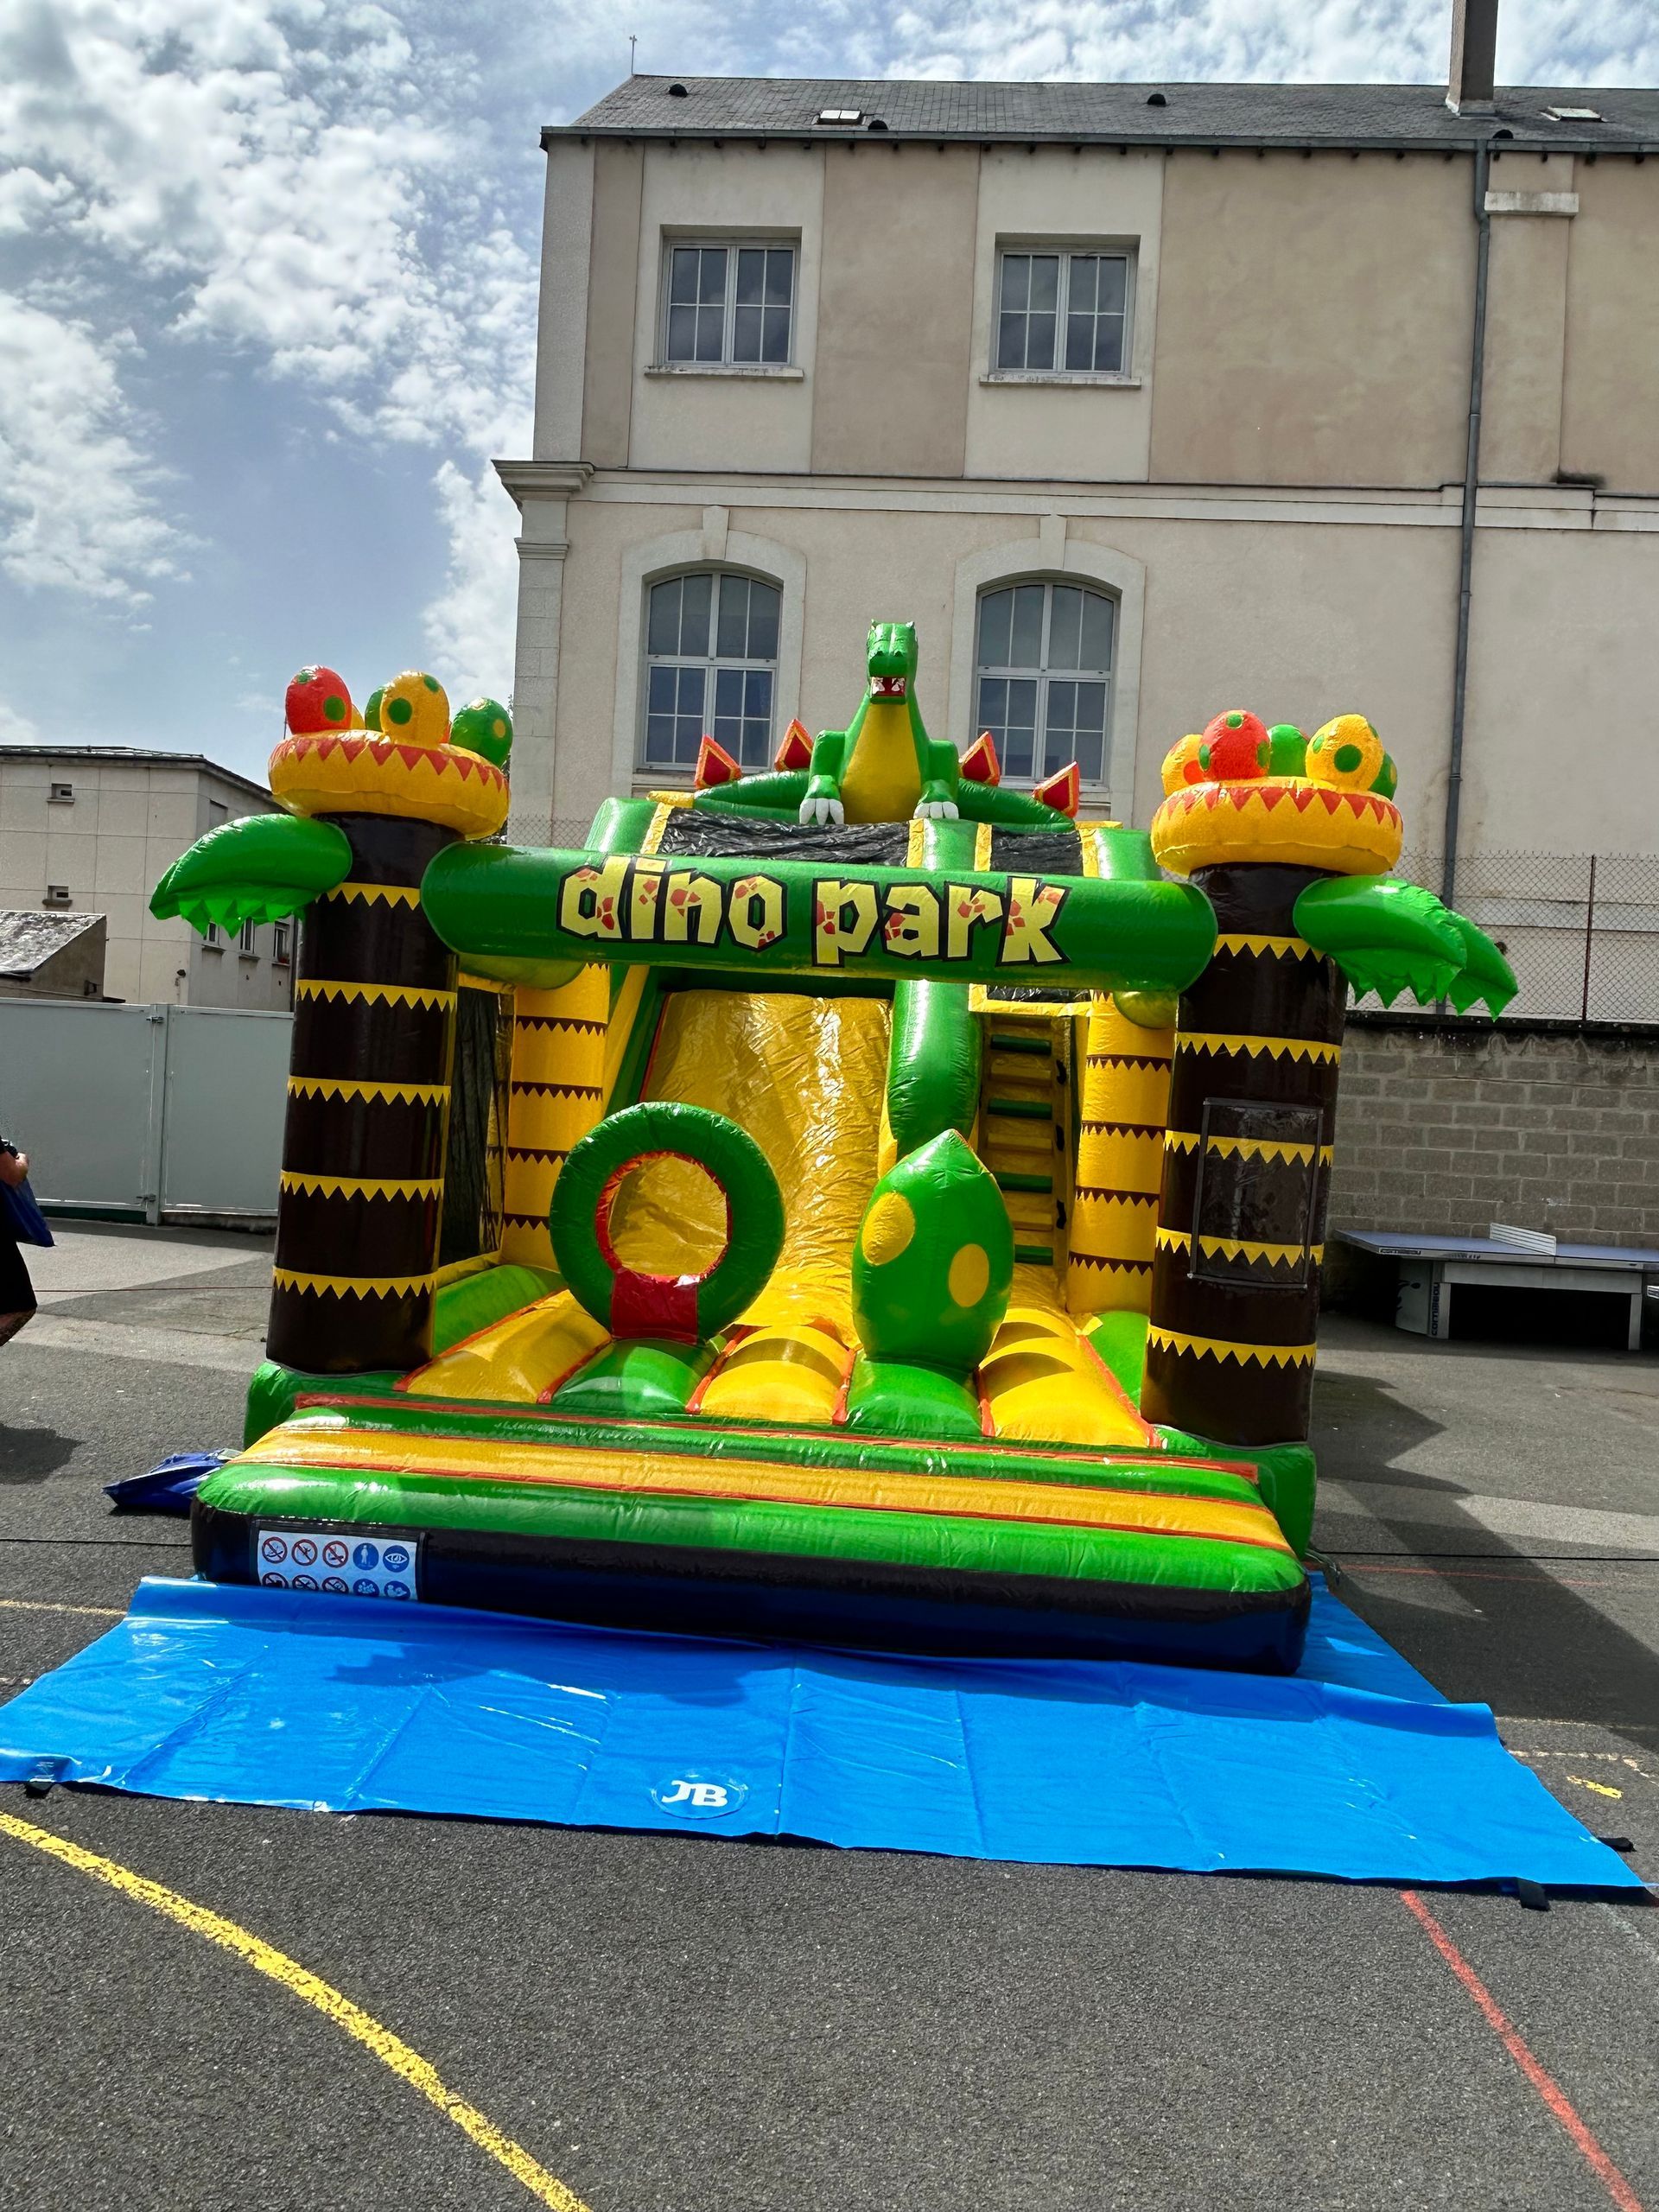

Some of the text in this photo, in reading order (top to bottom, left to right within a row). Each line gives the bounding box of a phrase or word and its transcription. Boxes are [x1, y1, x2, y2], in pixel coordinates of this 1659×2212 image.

[556, 855, 1071, 968] dino park
[661, 1780, 728, 1807] JB
